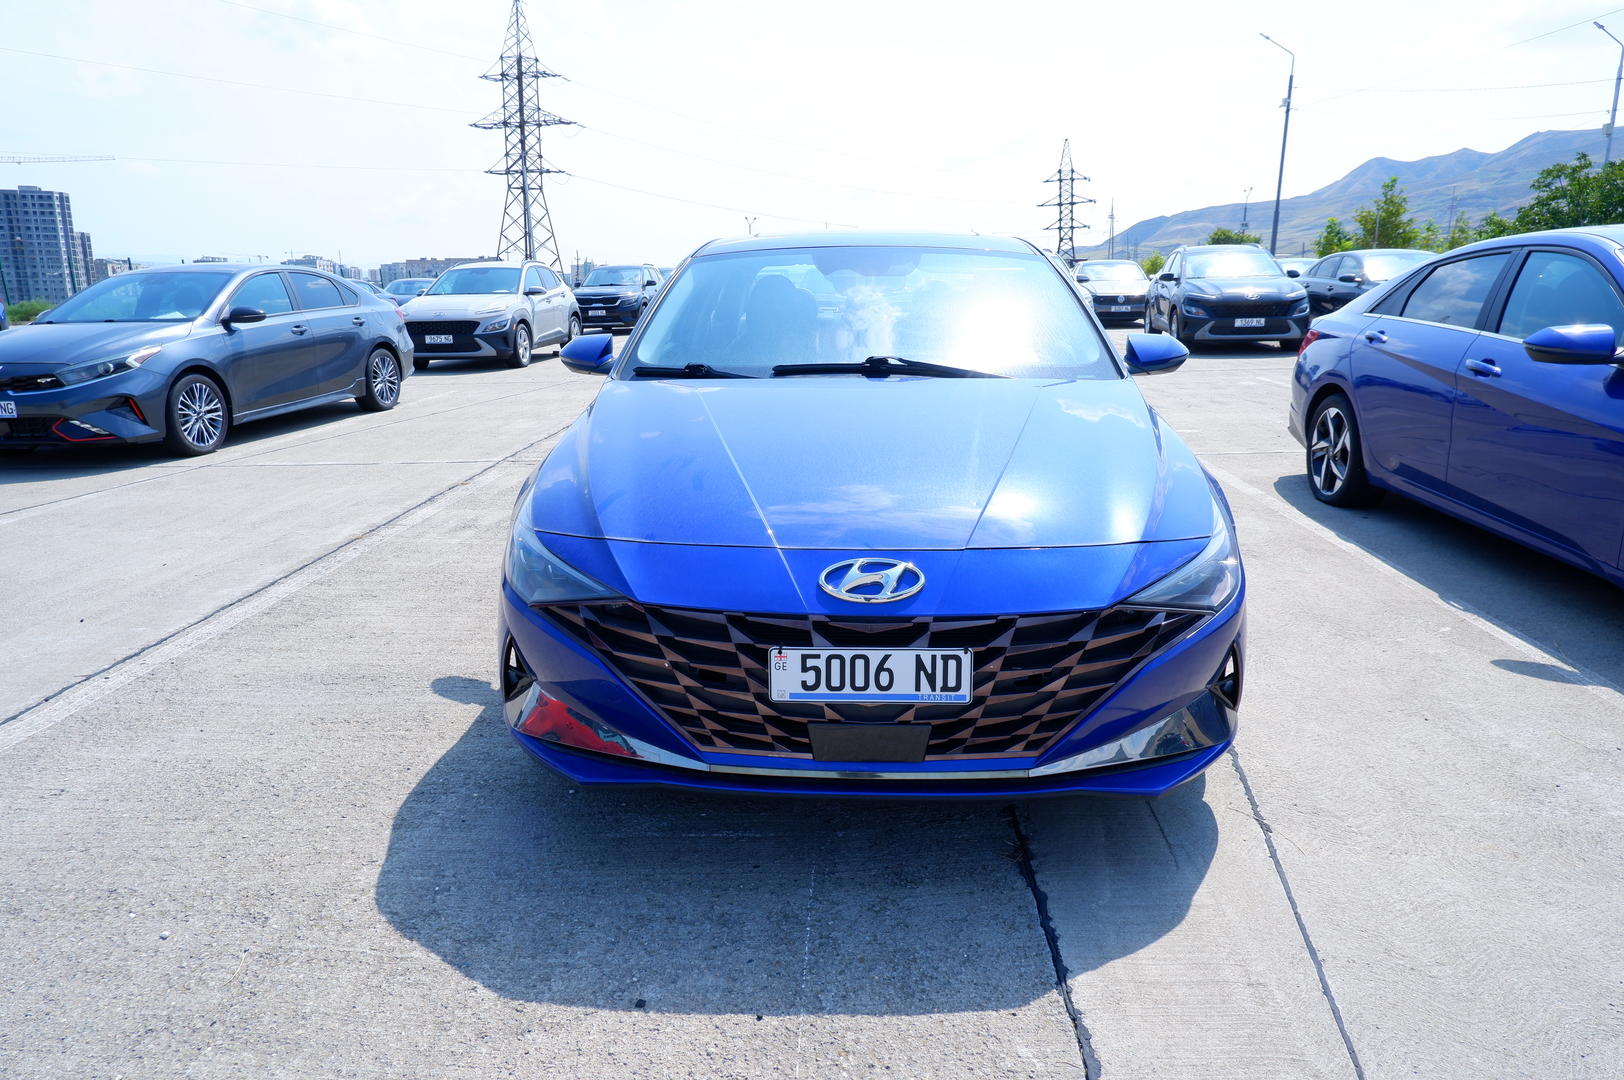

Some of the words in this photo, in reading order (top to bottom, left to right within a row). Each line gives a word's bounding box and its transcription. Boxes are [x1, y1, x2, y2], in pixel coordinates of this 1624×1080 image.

[774, 661, 788, 671] GE
[800, 653, 895, 692] 5006
[914, 654, 962, 692] ND
